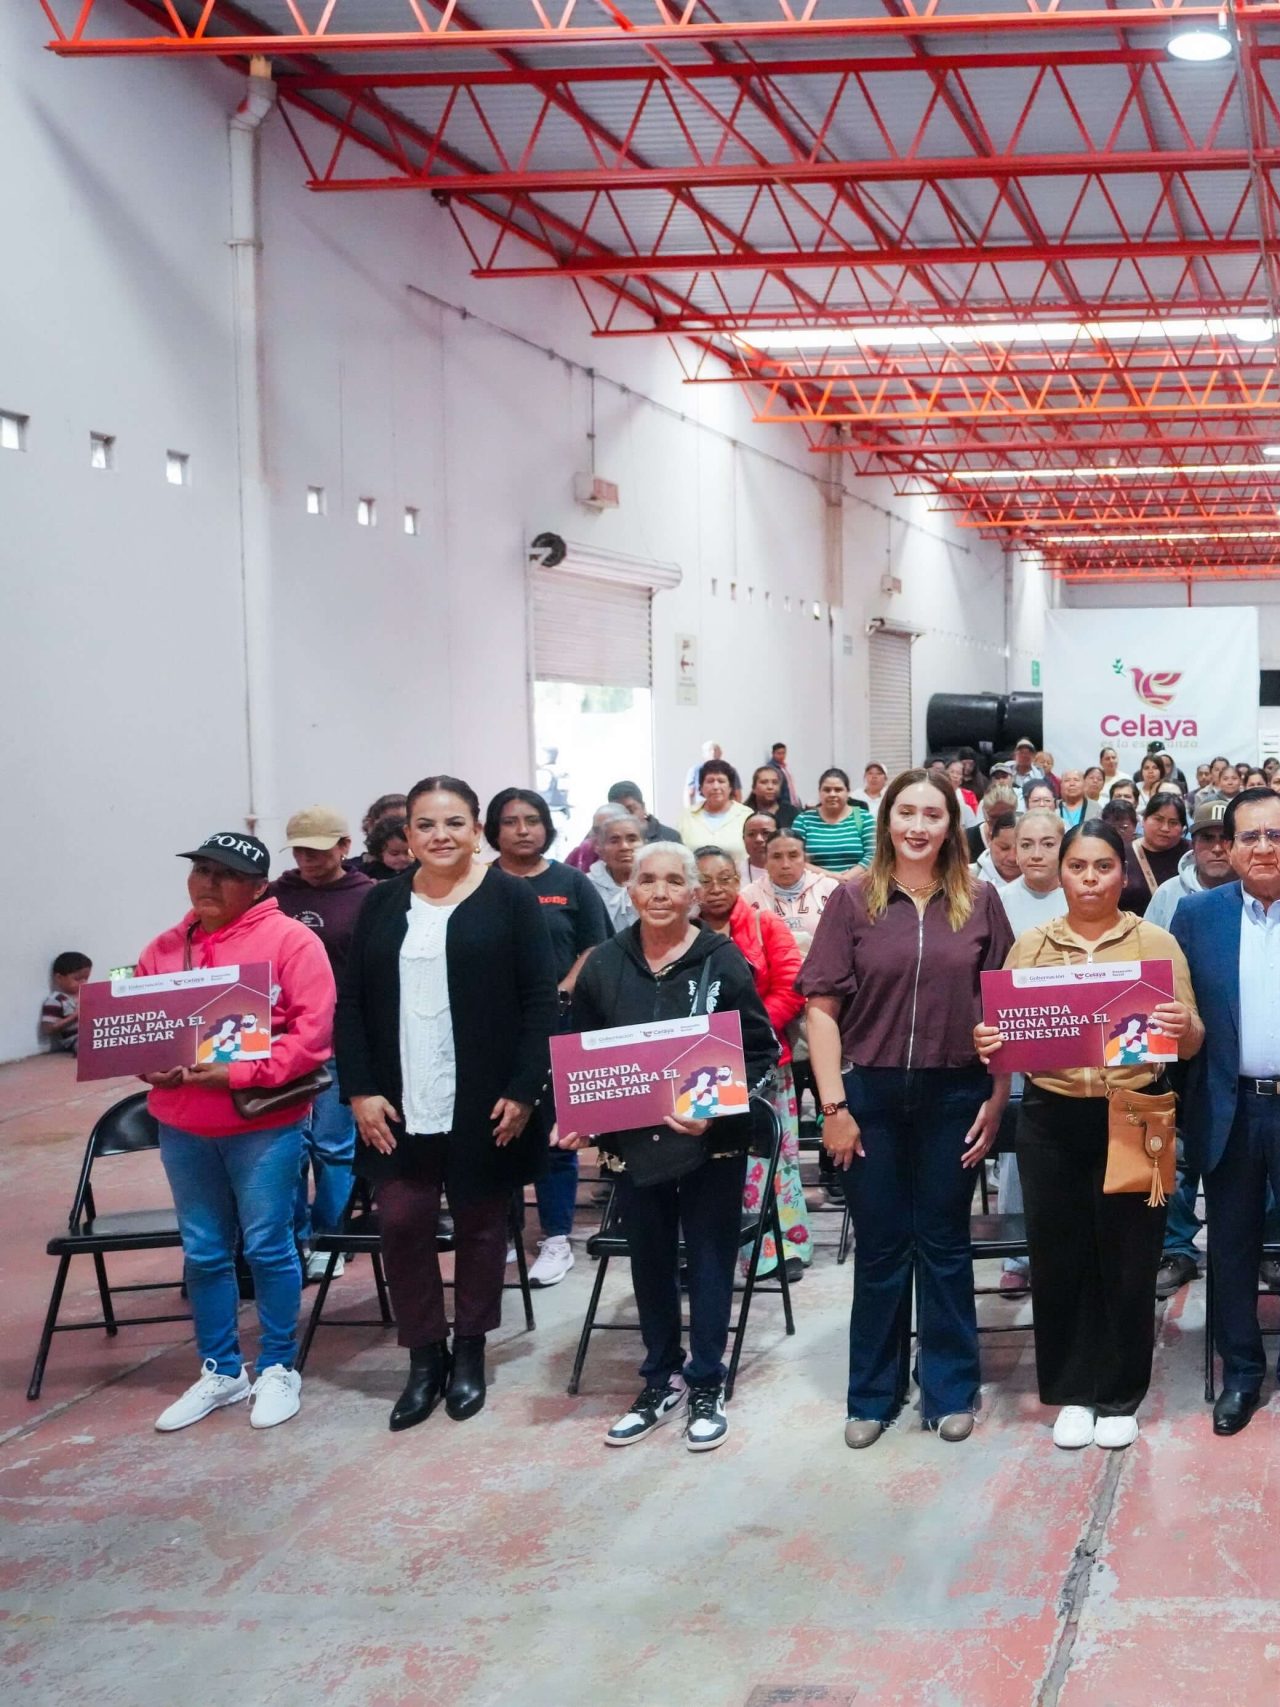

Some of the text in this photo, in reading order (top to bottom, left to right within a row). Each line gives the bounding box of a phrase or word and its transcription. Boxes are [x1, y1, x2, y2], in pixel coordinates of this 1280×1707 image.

[1100, 714, 1198, 741] Celaya
[93, 1010, 167, 1027] VIVIENDA
[998, 1005, 1071, 1018] VIVIENDA
[93, 1016, 206, 1039] DIGNA PARA EL
[1000, 1013, 1110, 1030] DIGNA PARA EL
[92, 1030, 175, 1049] BIENESTAR
[1001, 1027, 1080, 1041] BIENESTAR
[568, 1063, 641, 1082] VIVIENDA
[569, 1069, 680, 1094] DIGNA PARA EL
[569, 1085, 651, 1104] BIENESTAR
